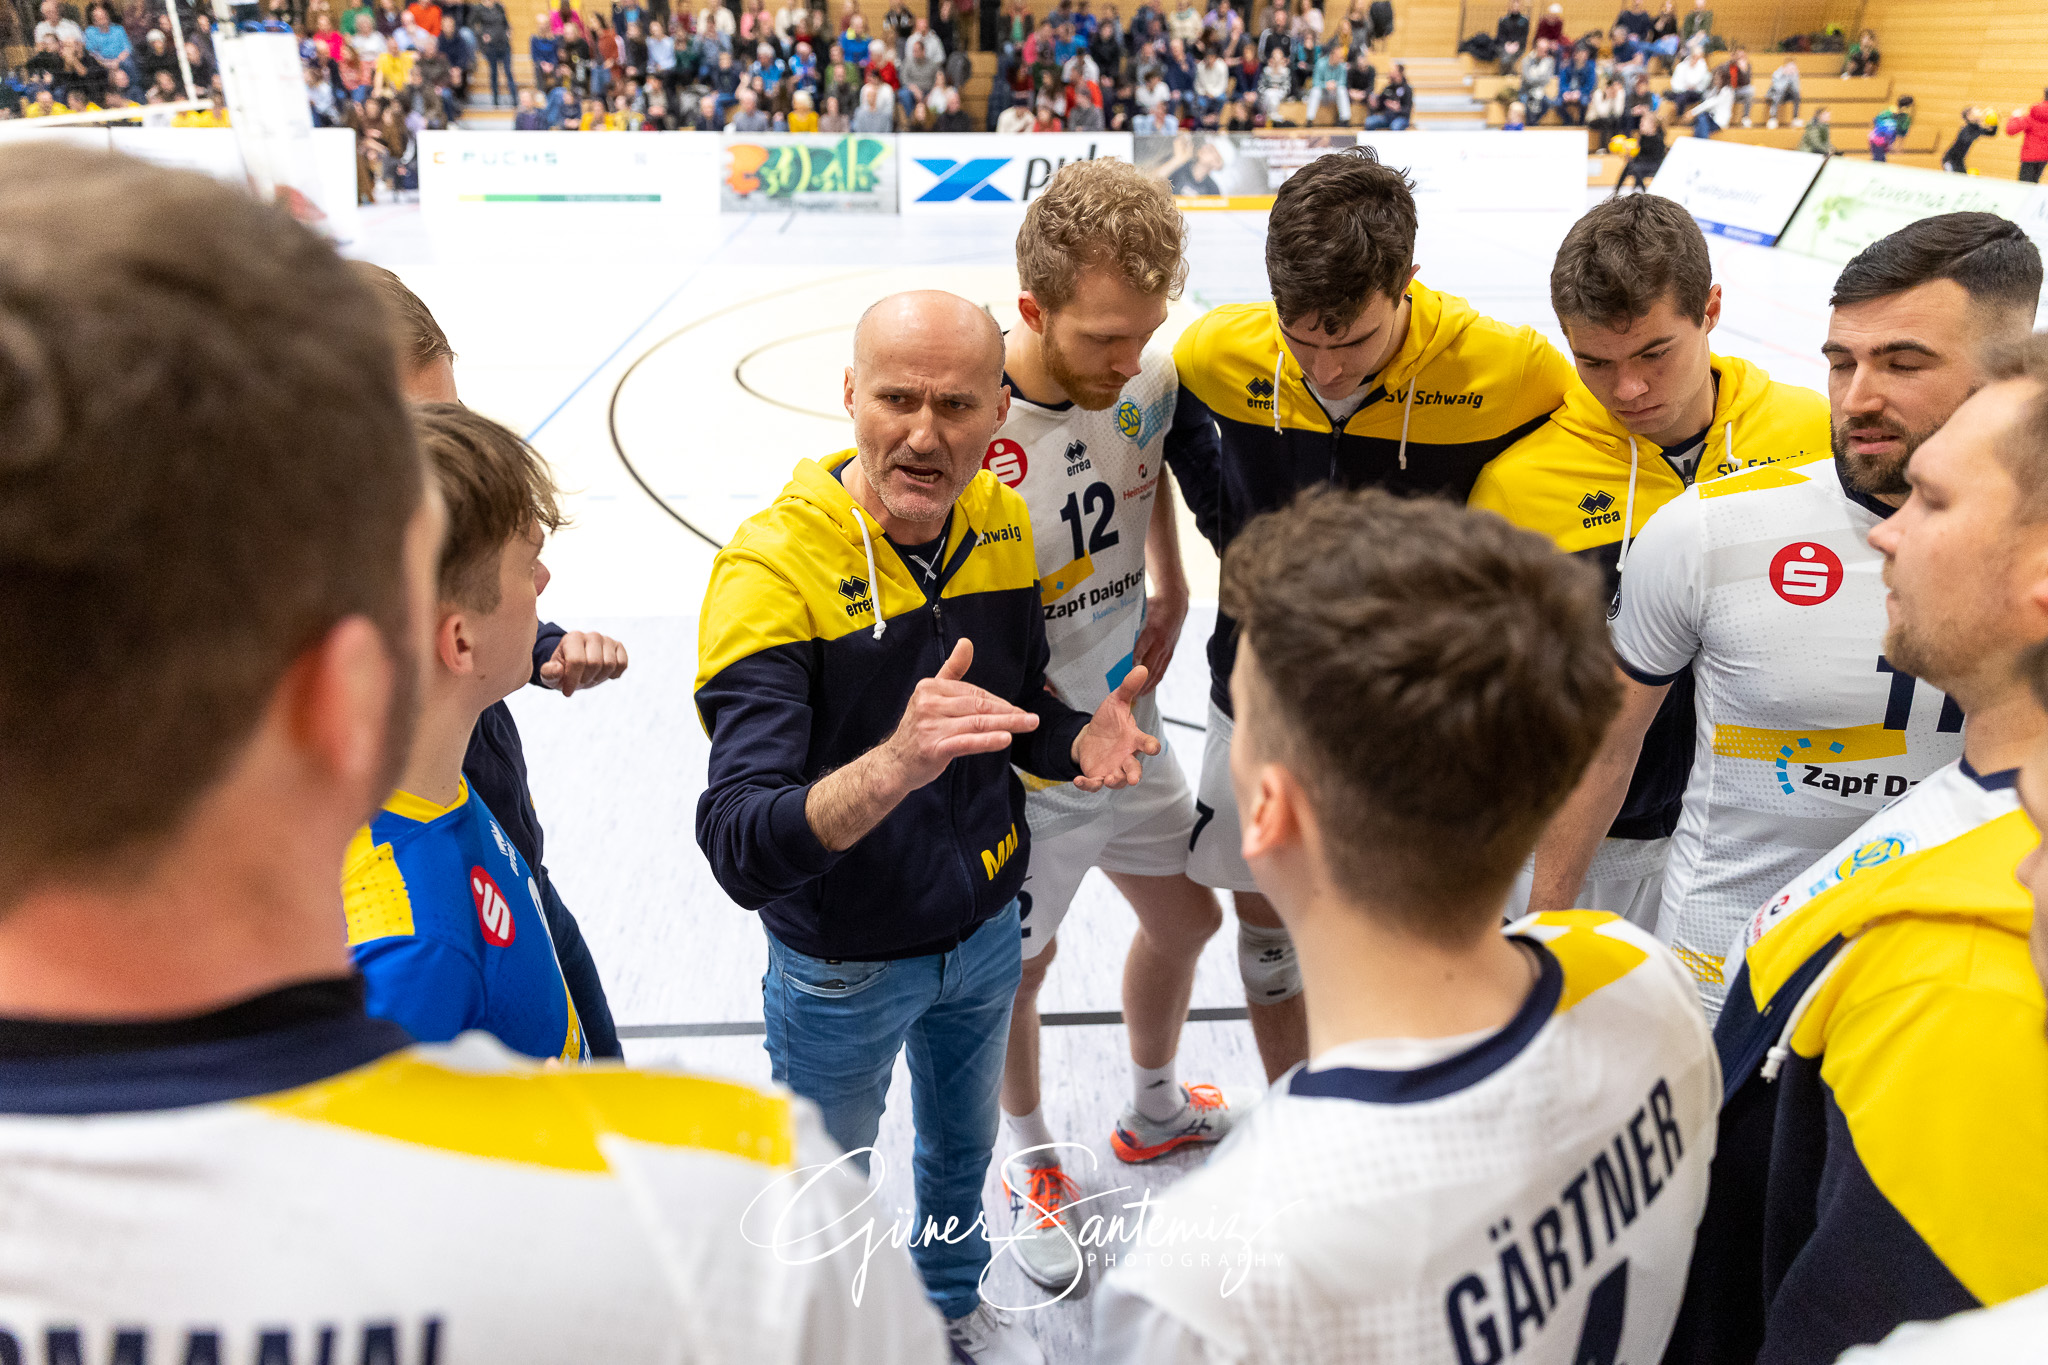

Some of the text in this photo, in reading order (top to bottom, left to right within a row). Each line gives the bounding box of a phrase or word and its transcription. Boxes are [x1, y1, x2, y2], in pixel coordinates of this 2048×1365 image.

[1385, 389, 1484, 409] SV Schwaig
[1066, 457, 1092, 477] errea
[1060, 481, 1120, 560] 12
[1582, 510, 1621, 529] errea
[1043, 592, 1087, 620] Zapf
[1802, 764, 1880, 798] Zapf
[1445, 1076, 1686, 1365] GÄRTNER
